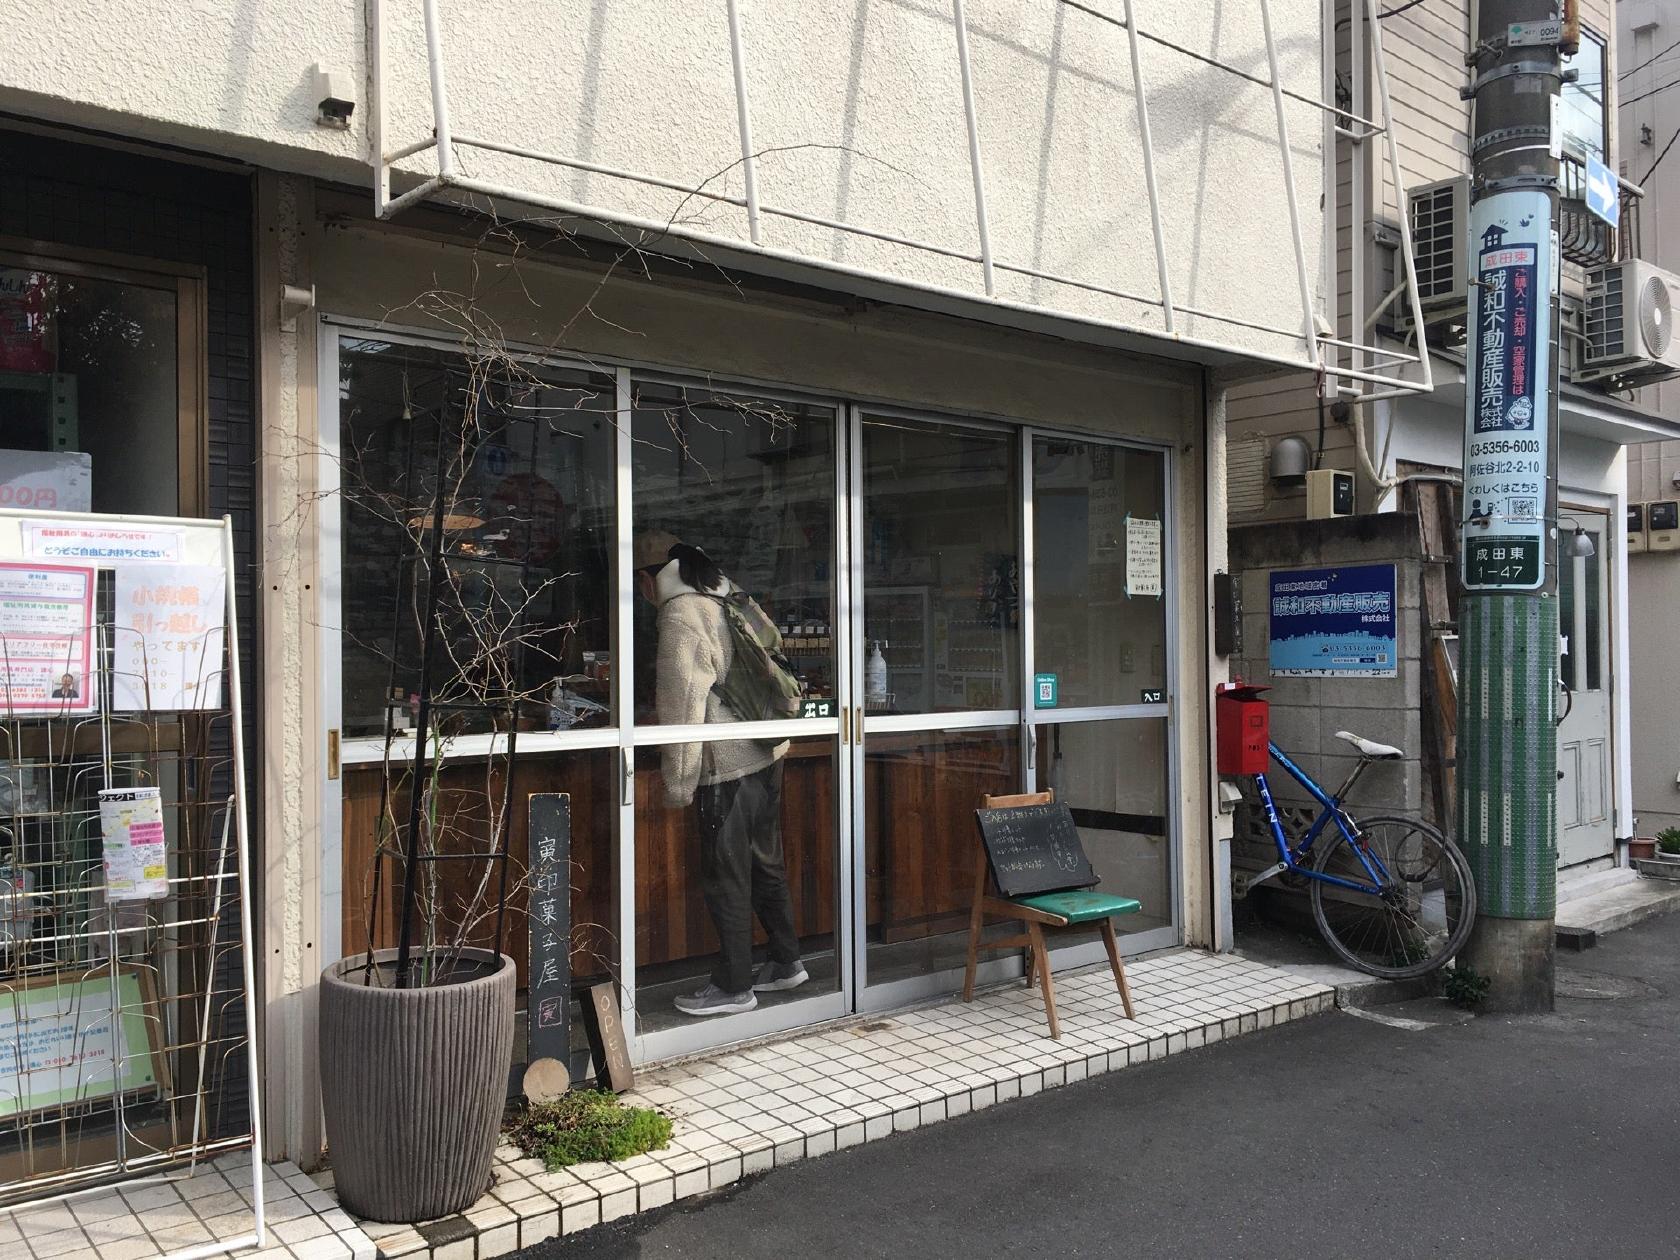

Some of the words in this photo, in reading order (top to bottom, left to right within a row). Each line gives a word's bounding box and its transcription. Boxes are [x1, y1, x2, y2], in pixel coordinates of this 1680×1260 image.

[1485, 250, 1528, 268] 成田東
[1481, 269, 1507, 408] 誠和不動産販売
[1470, 440, 1540, 457] 03-5356-6003
[1469, 460, 1540, 478] 阿佐谷北2-2-10
[1468, 483, 1539, 495] くわしくはこちら
[1476, 547, 1524, 561] 成田東
[1273, 591, 1391, 616] 誠和不動産販売
[1361, 614, 1390, 623] 株式会社
[132, 640, 201, 652] やってます
[804, 703, 829, 717] 出口
[600, 995, 625, 1070] OPEN
